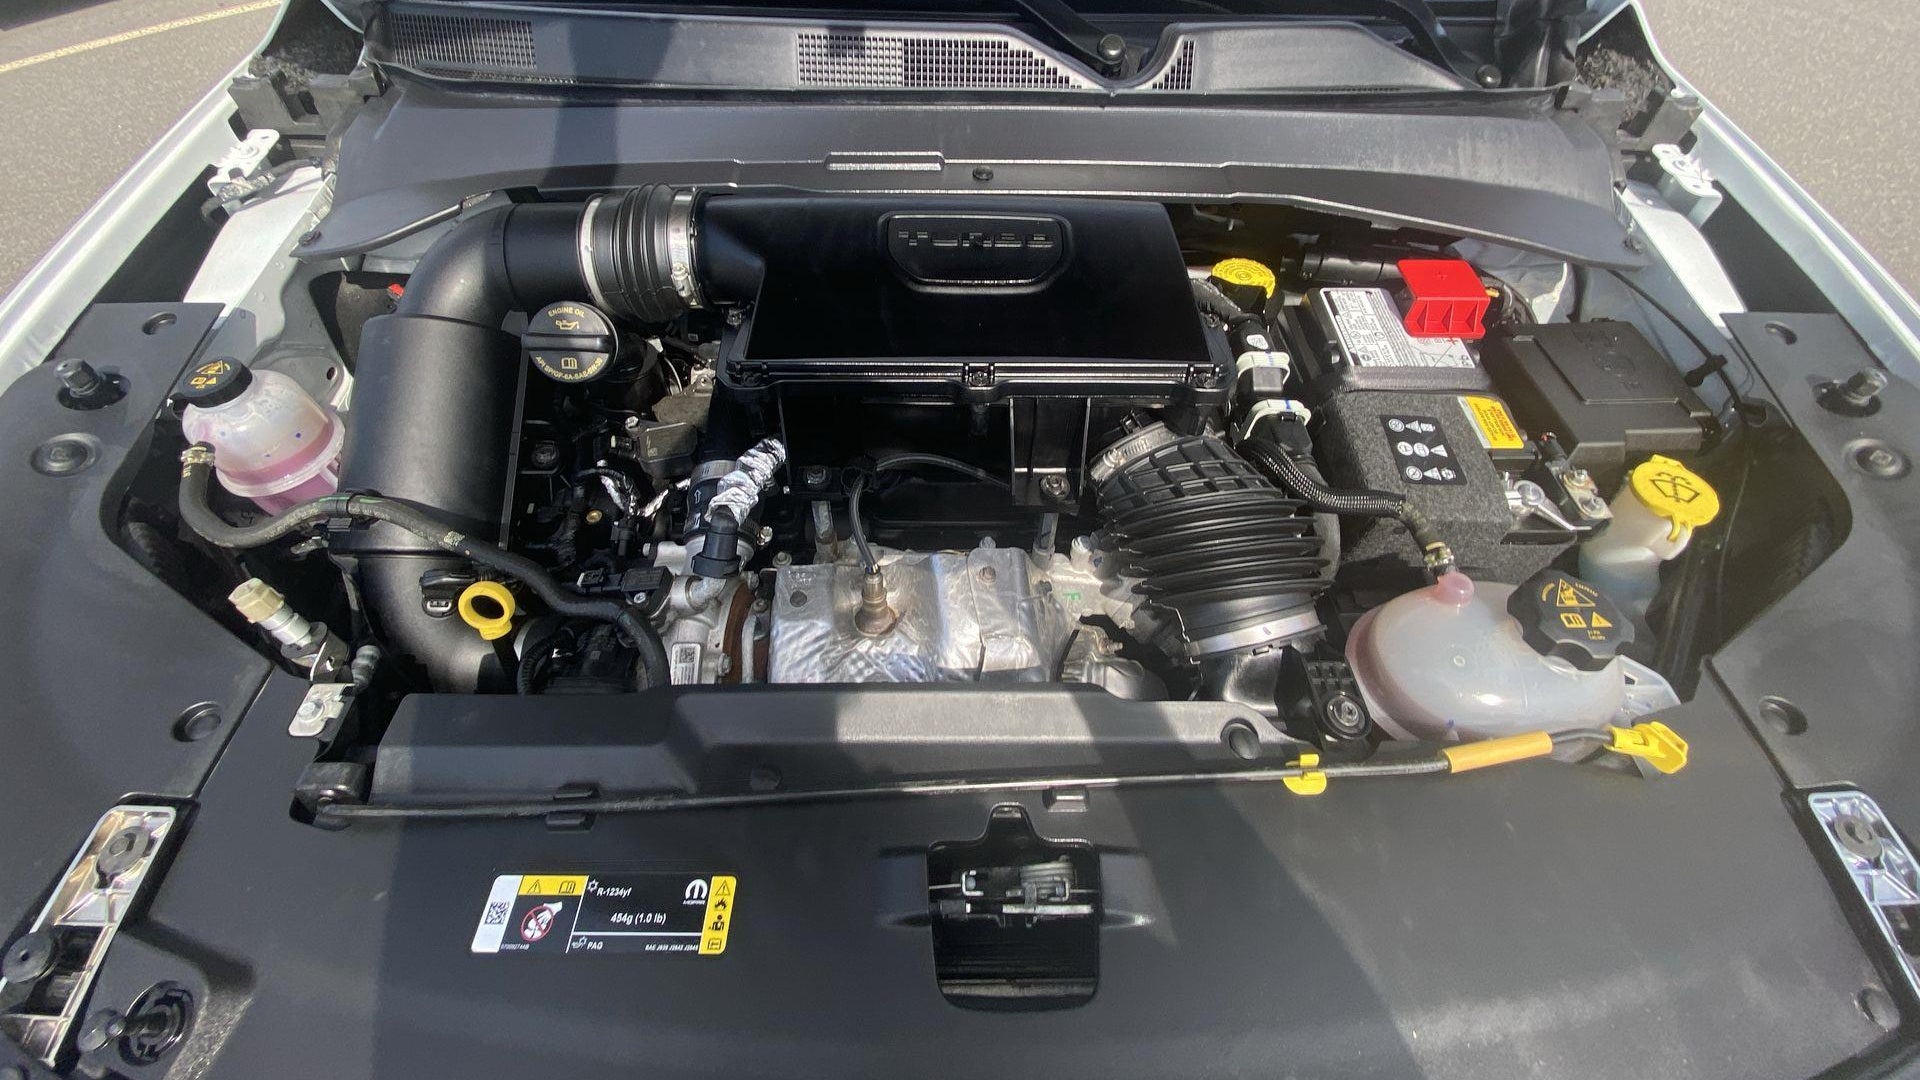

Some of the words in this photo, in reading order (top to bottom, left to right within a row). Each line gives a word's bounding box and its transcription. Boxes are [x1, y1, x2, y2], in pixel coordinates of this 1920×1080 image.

[547, 306, 574, 317] ENGINE
[574, 308, 585, 318] OIL
[535, 356, 545, 368] API
[596, 887, 632, 898] R-1234yf
[610, 913, 634, 925] 454g
